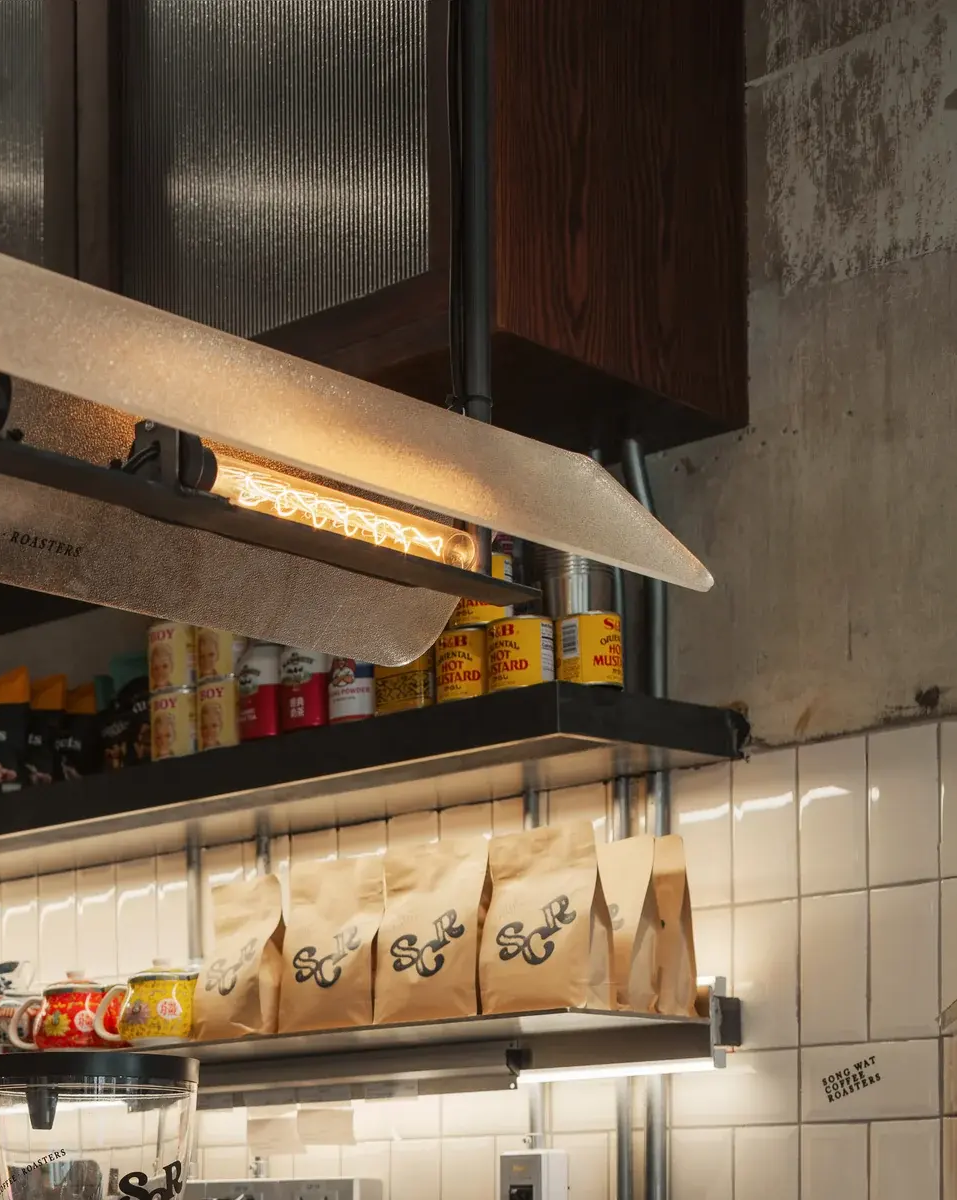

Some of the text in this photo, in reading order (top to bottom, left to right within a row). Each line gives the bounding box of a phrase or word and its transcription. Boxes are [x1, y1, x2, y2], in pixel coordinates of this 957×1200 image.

[10, 531, 83, 557] ROASTERS
[390, 908, 465, 978] SCR
[496, 894, 577, 966] SCR
[293, 925, 362, 989] SCR
[822, 1055, 876, 1086] SONG WAT
[825, 1071, 865, 1094] COFFEE
[827, 1073, 881, 1103] ROASTERS
[21, 1148, 67, 1176] ROASTERS
